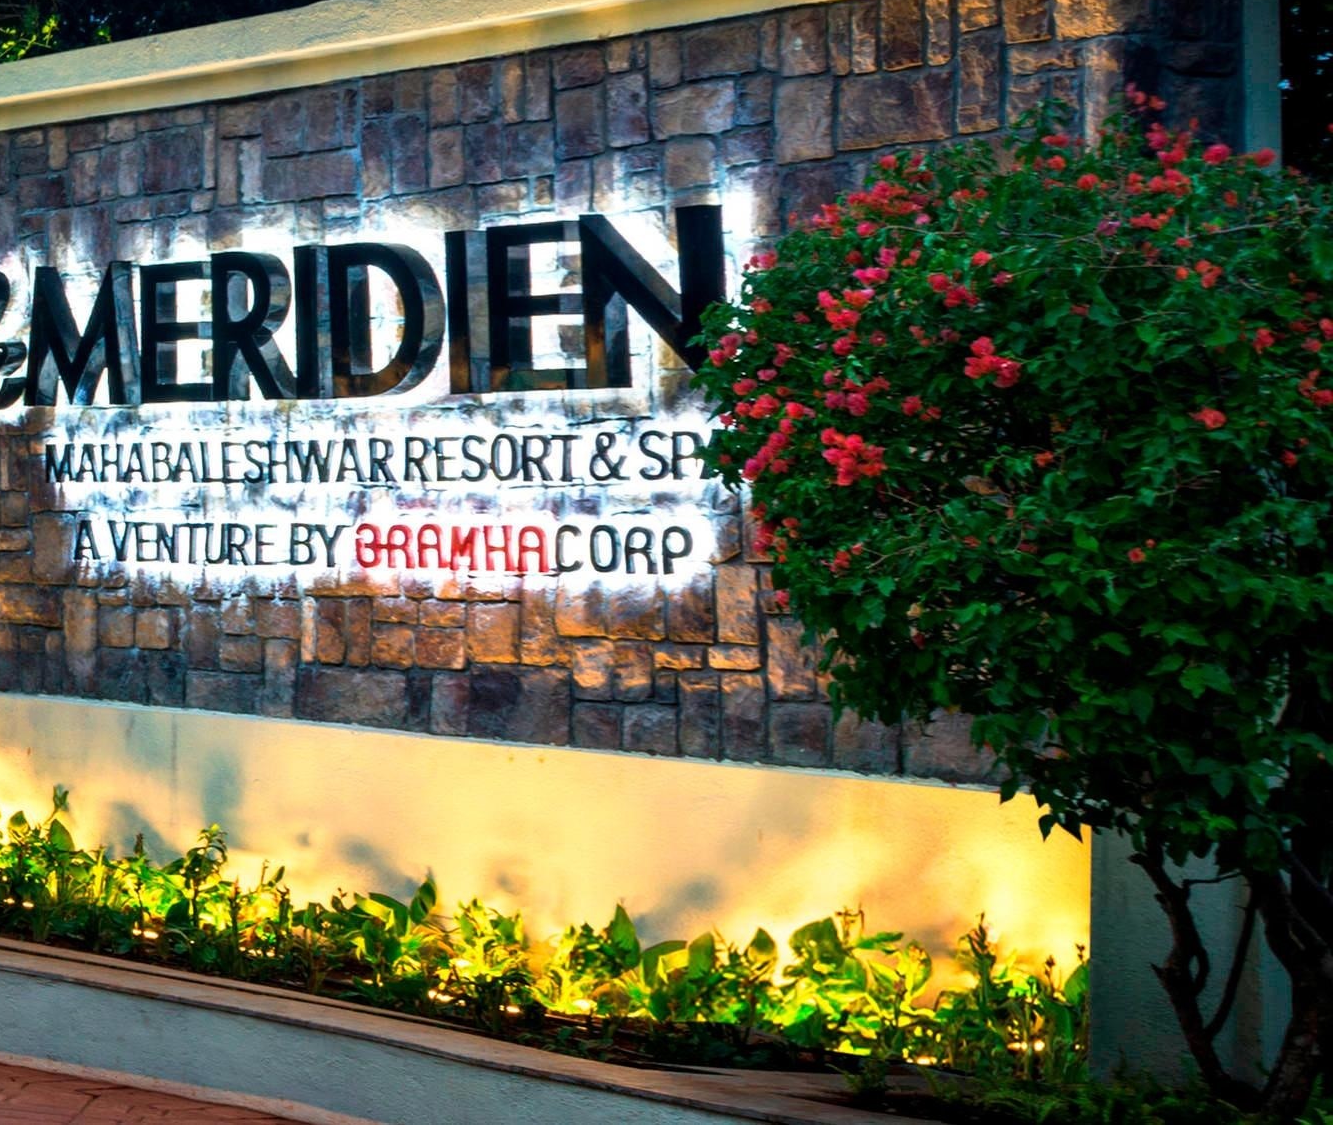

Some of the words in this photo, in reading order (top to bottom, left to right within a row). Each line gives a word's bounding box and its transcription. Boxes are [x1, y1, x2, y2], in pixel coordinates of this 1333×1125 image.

[24, 204, 726, 408] MERIDIEN
[45, 437, 397, 483] MAHABALESHWAR
[404, 432, 583, 482] RESORT
[589, 431, 631, 481] &
[637, 430, 715, 481] SP
[74, 520, 100, 561] A
[108, 521, 278, 566] VENTURE
[289, 523, 353, 568] BY
